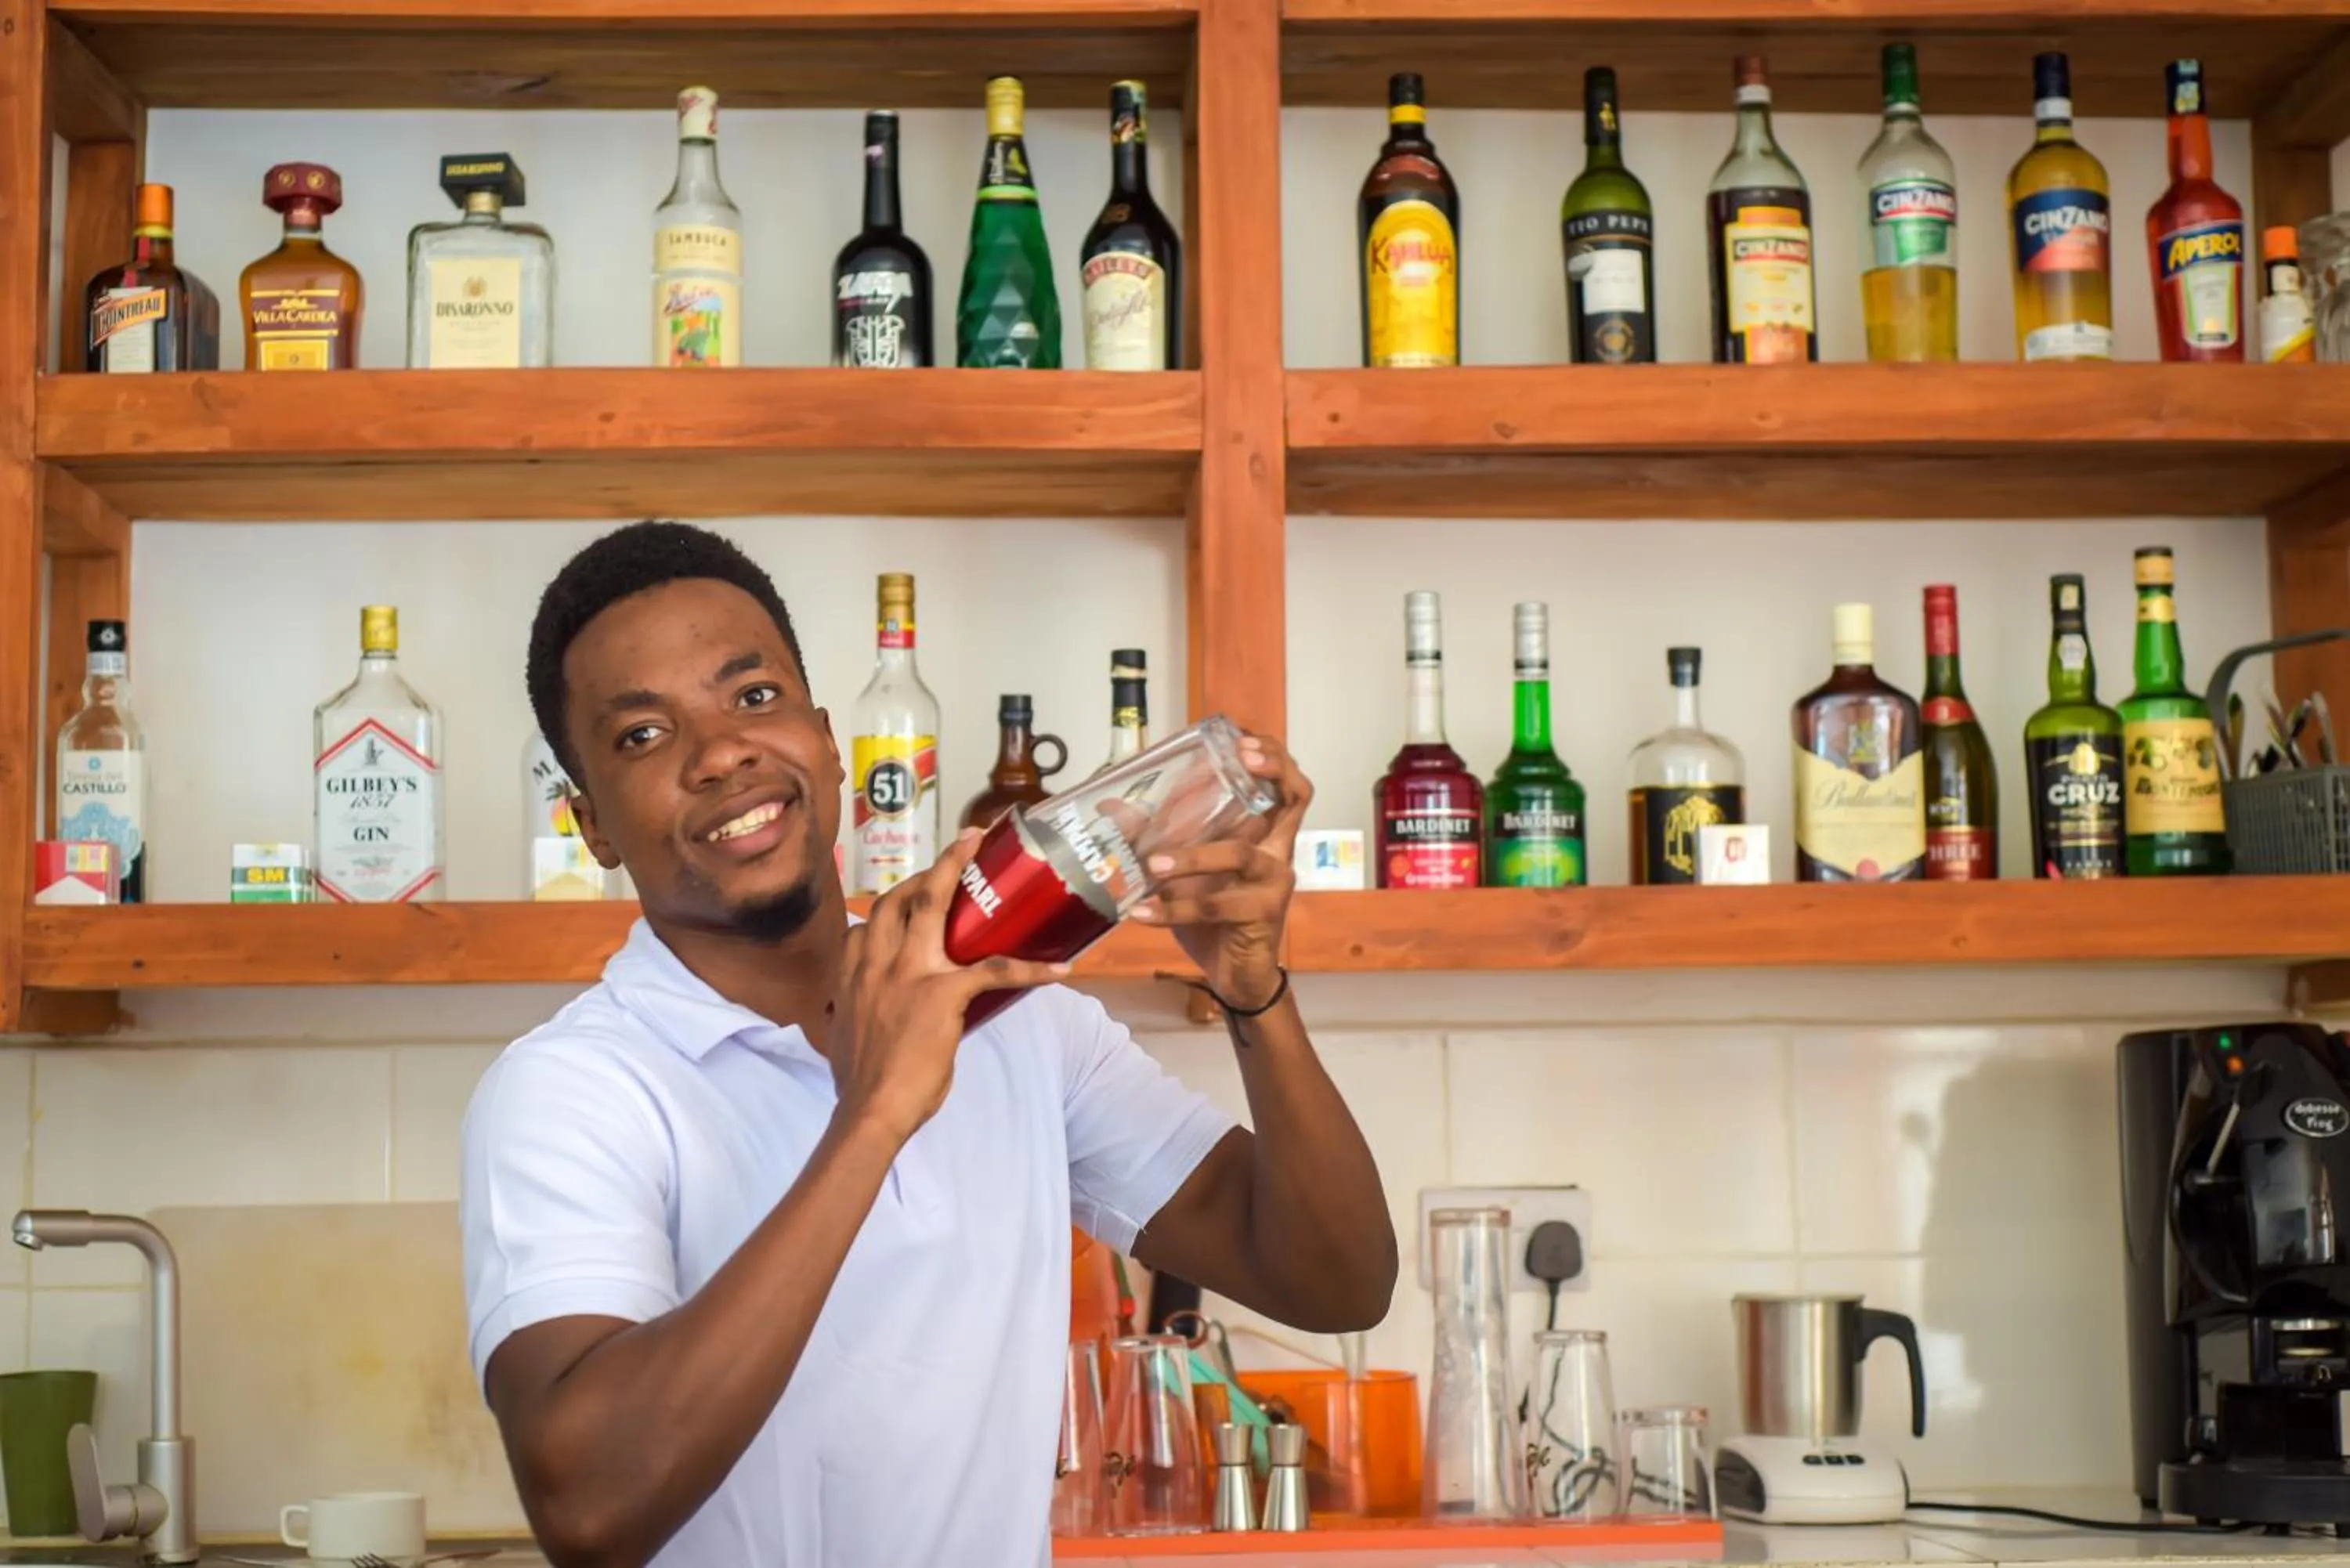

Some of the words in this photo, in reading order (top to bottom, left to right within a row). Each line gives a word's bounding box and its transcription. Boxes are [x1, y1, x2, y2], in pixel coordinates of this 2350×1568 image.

[63, 782, 126, 795] CASTILLO
[326, 776, 418, 793] GILBEY'S
[873, 771, 906, 804] 51
[350, 794, 396, 810] 1857
[2048, 782, 2120, 805] CRUZ
[353, 826, 389, 843] GIN
[1396, 818, 1470, 834] BARDINET
[247, 866, 285, 884] SM
